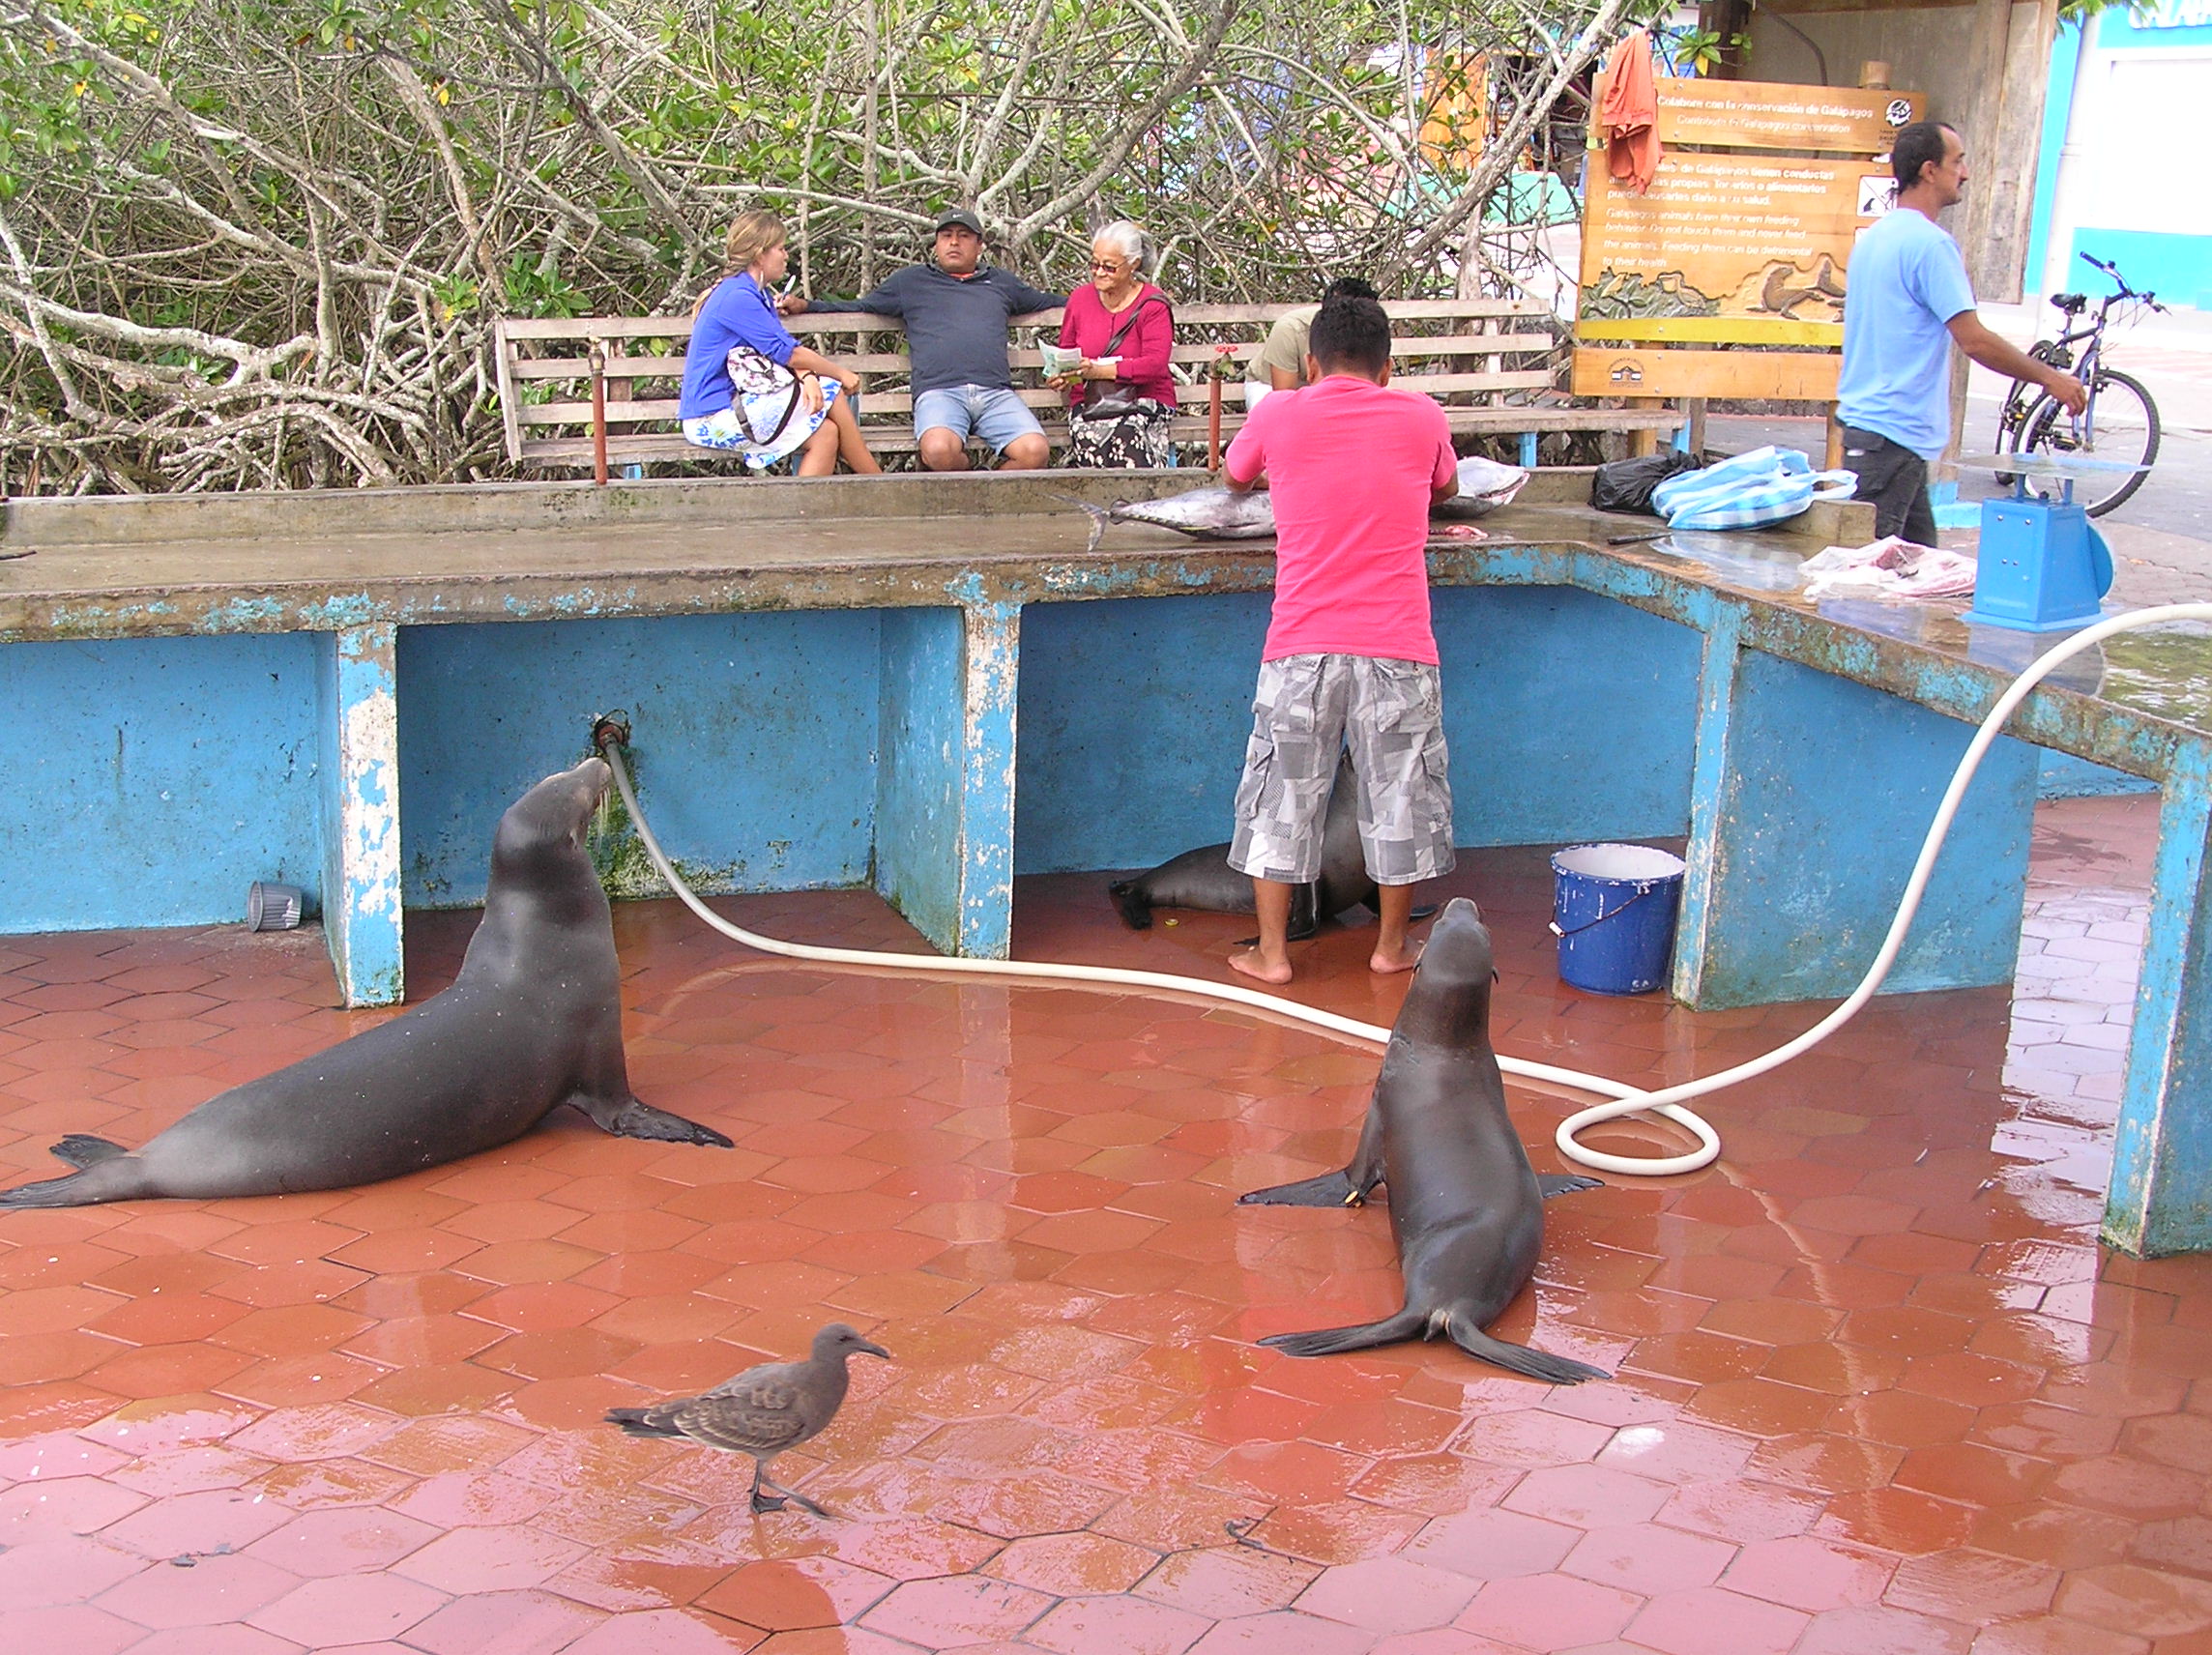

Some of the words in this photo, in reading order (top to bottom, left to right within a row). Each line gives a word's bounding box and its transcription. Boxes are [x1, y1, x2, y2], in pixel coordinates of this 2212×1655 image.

[1704, 100, 1725, 109] con
[1806, 103, 1819, 115] de
[1820, 104, 1873, 119] Galápagos
[1680, 163, 1695, 173] de
[1751, 168, 1782, 178] tienen
[1783, 169, 1835, 181] conductas
[1757, 183, 1765, 191] o
[1719, 195, 1727, 204] a
[1764, 215, 1800, 227] feeding
[1665, 226, 1682, 235] not
[1683, 225, 1710, 236] touch
[1711, 227, 1736, 238] them
[1737, 228, 1757, 239] and
[1758, 229, 1784, 239] never
[1784, 229, 1807, 241] feed
[1603, 239, 1620, 249] the
[1662, 241, 1701, 255] Feeding
[1702, 244, 1727, 254] them
[1728, 246, 1745, 254] can
[1746, 246, 1760, 255] be
[1761, 246, 1813, 258] detrimental
[1602, 256, 1613, 267] to
[1614, 256, 1638, 268] their
